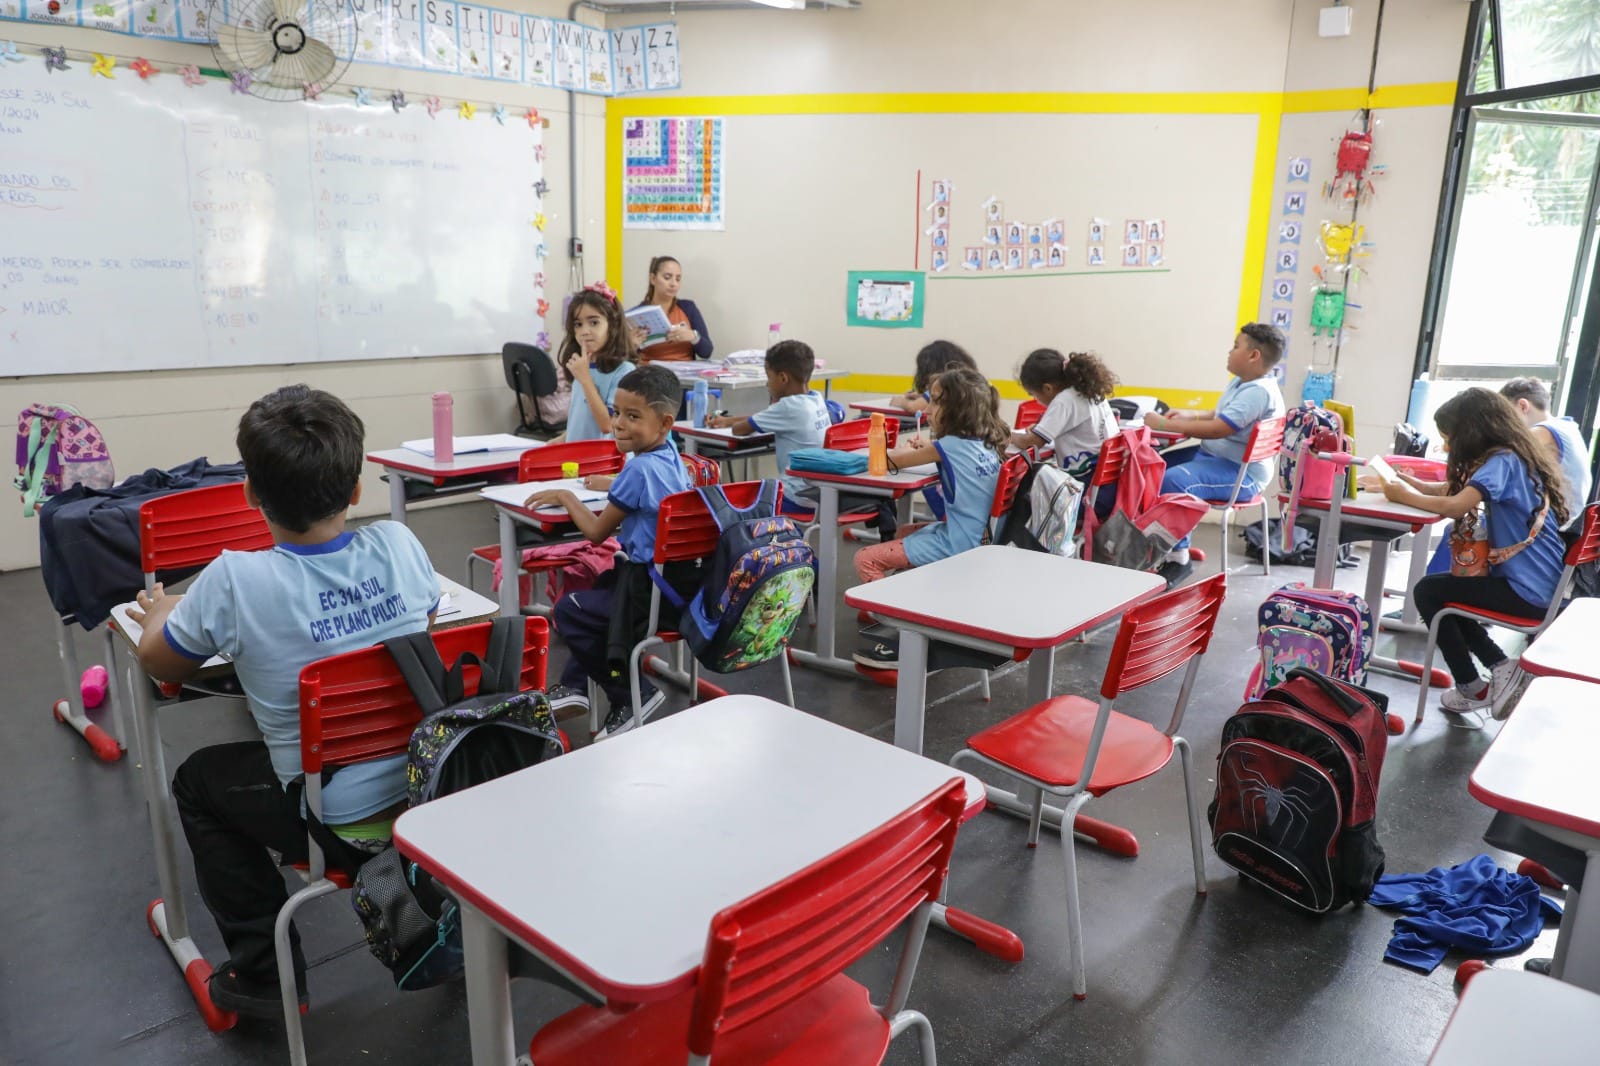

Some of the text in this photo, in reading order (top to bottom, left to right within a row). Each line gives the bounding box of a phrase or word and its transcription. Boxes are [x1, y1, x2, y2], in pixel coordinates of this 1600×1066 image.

[392, 0, 403, 19] R
[426, 1, 454, 26] S s
[462, 7, 471, 30] T
[96, 21, 115, 32] KIWI
[493, 13, 519, 37] U u
[526, 19, 537, 43] V
[556, 23, 571, 45] W
[586, 30, 606, 53] X x
[614, 31, 639, 56] Y y
[648, 28, 673, 48] Z z
[51, 175, 72, 188] OS
[22, 298, 73, 316] MAIOR
[318, 576, 385, 611] EC 314 SUL
[309, 593, 407, 643] CRE PLANO PILOTO
